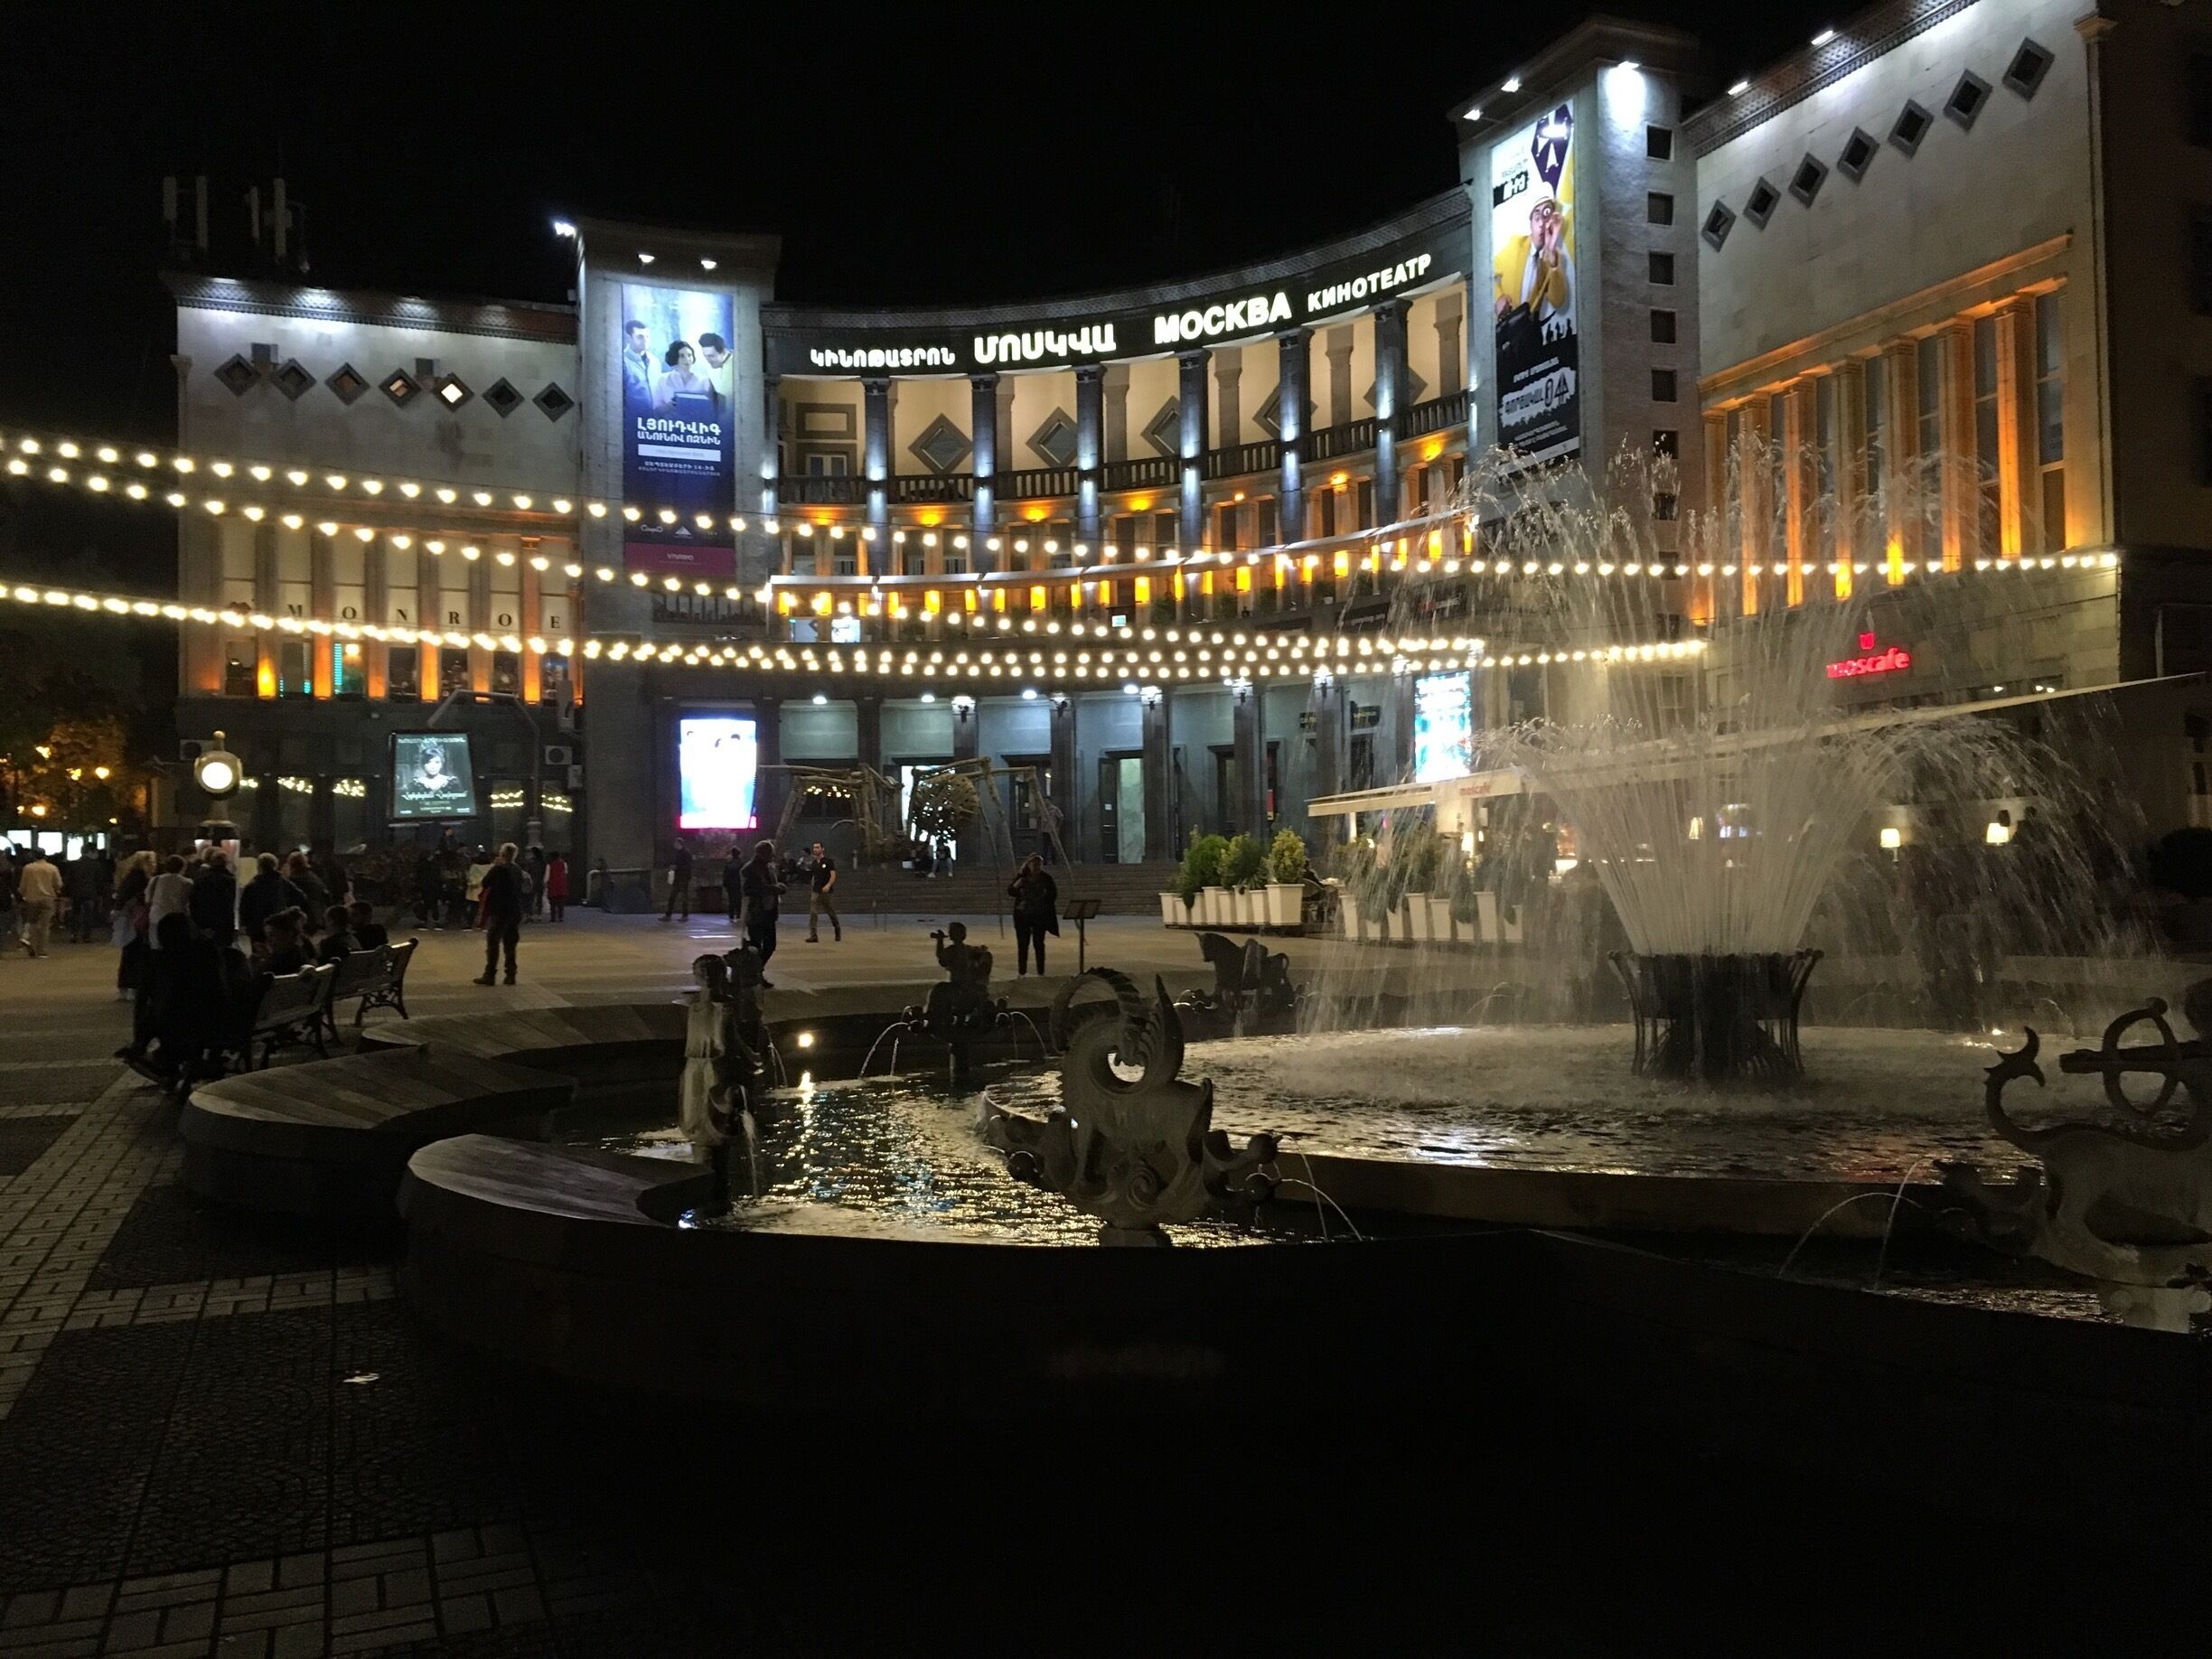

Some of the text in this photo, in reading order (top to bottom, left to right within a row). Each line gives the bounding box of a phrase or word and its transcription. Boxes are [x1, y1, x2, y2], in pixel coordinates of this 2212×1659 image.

[1154, 253, 1432, 344] МОСКВА КИНОТЕАТР
[811, 323, 1116, 368] ԿԻՆՈԹԱՏՐՈՆ ՄՈՍԿՎԱ
[637, 417, 721, 436] ԼՅՈՒԴՎԻԳ
[637, 431, 721, 445] ԱՆՈՒՆՈՎ ՈԶՆԻՆ
[287, 603, 561, 629] MONROE
